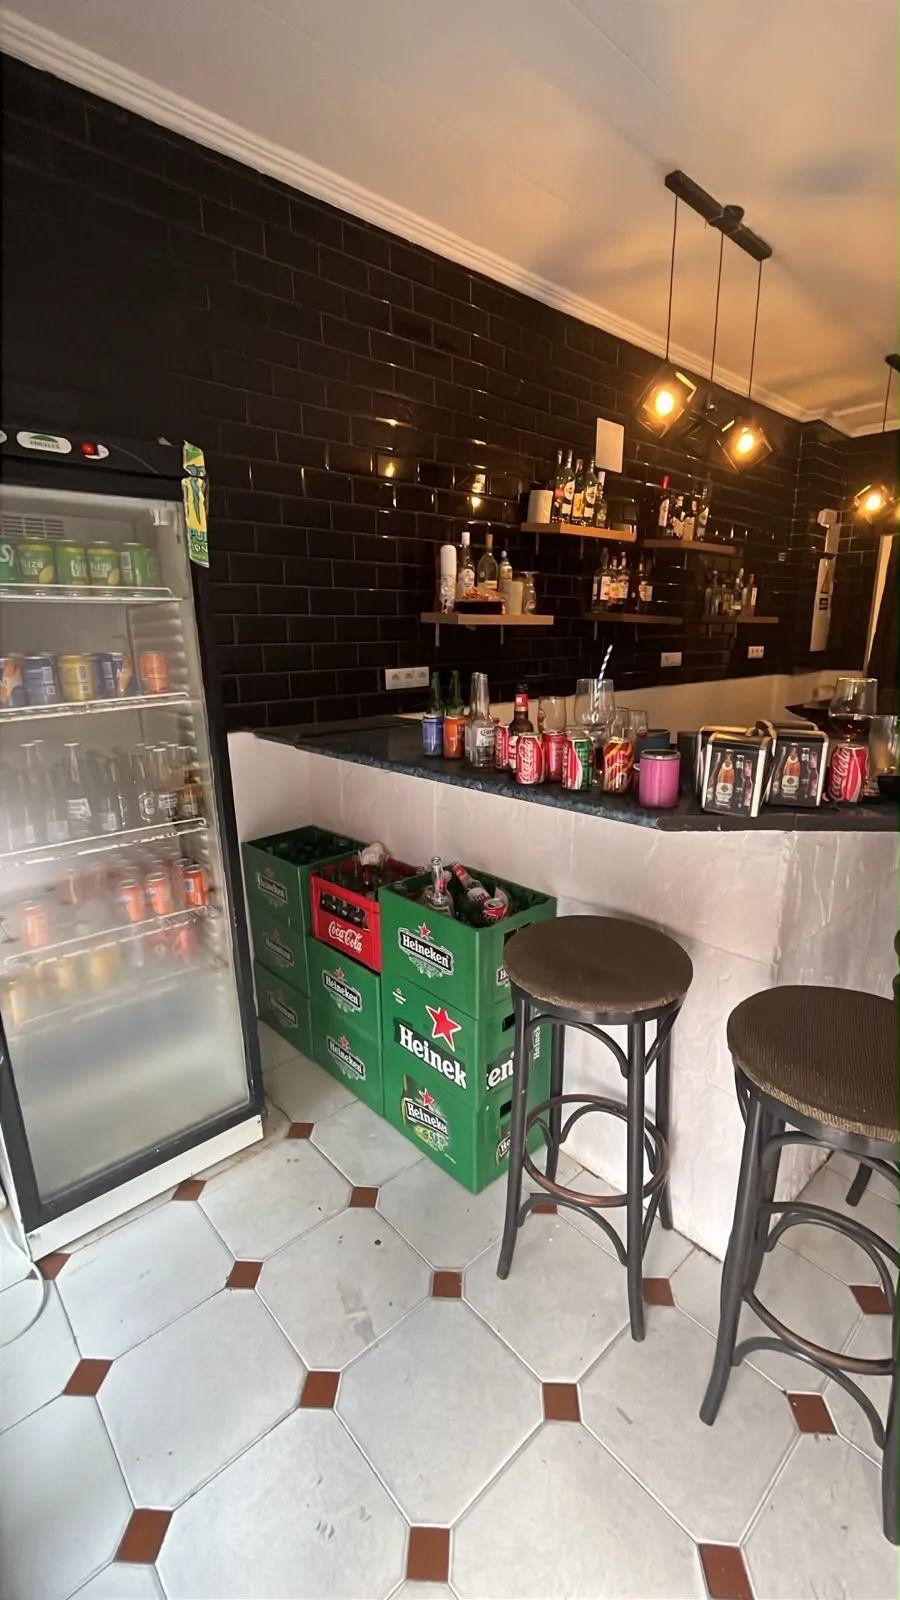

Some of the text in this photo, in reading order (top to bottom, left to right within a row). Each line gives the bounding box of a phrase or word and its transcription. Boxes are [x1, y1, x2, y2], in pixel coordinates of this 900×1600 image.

[402, 934, 450, 968] Heineken
[325, 975, 359, 1006] Heineken
[330, 1040, 363, 1074] Heineken
[399, 1023, 467, 1090] Heinek
[487, 1059, 514, 1090] en
